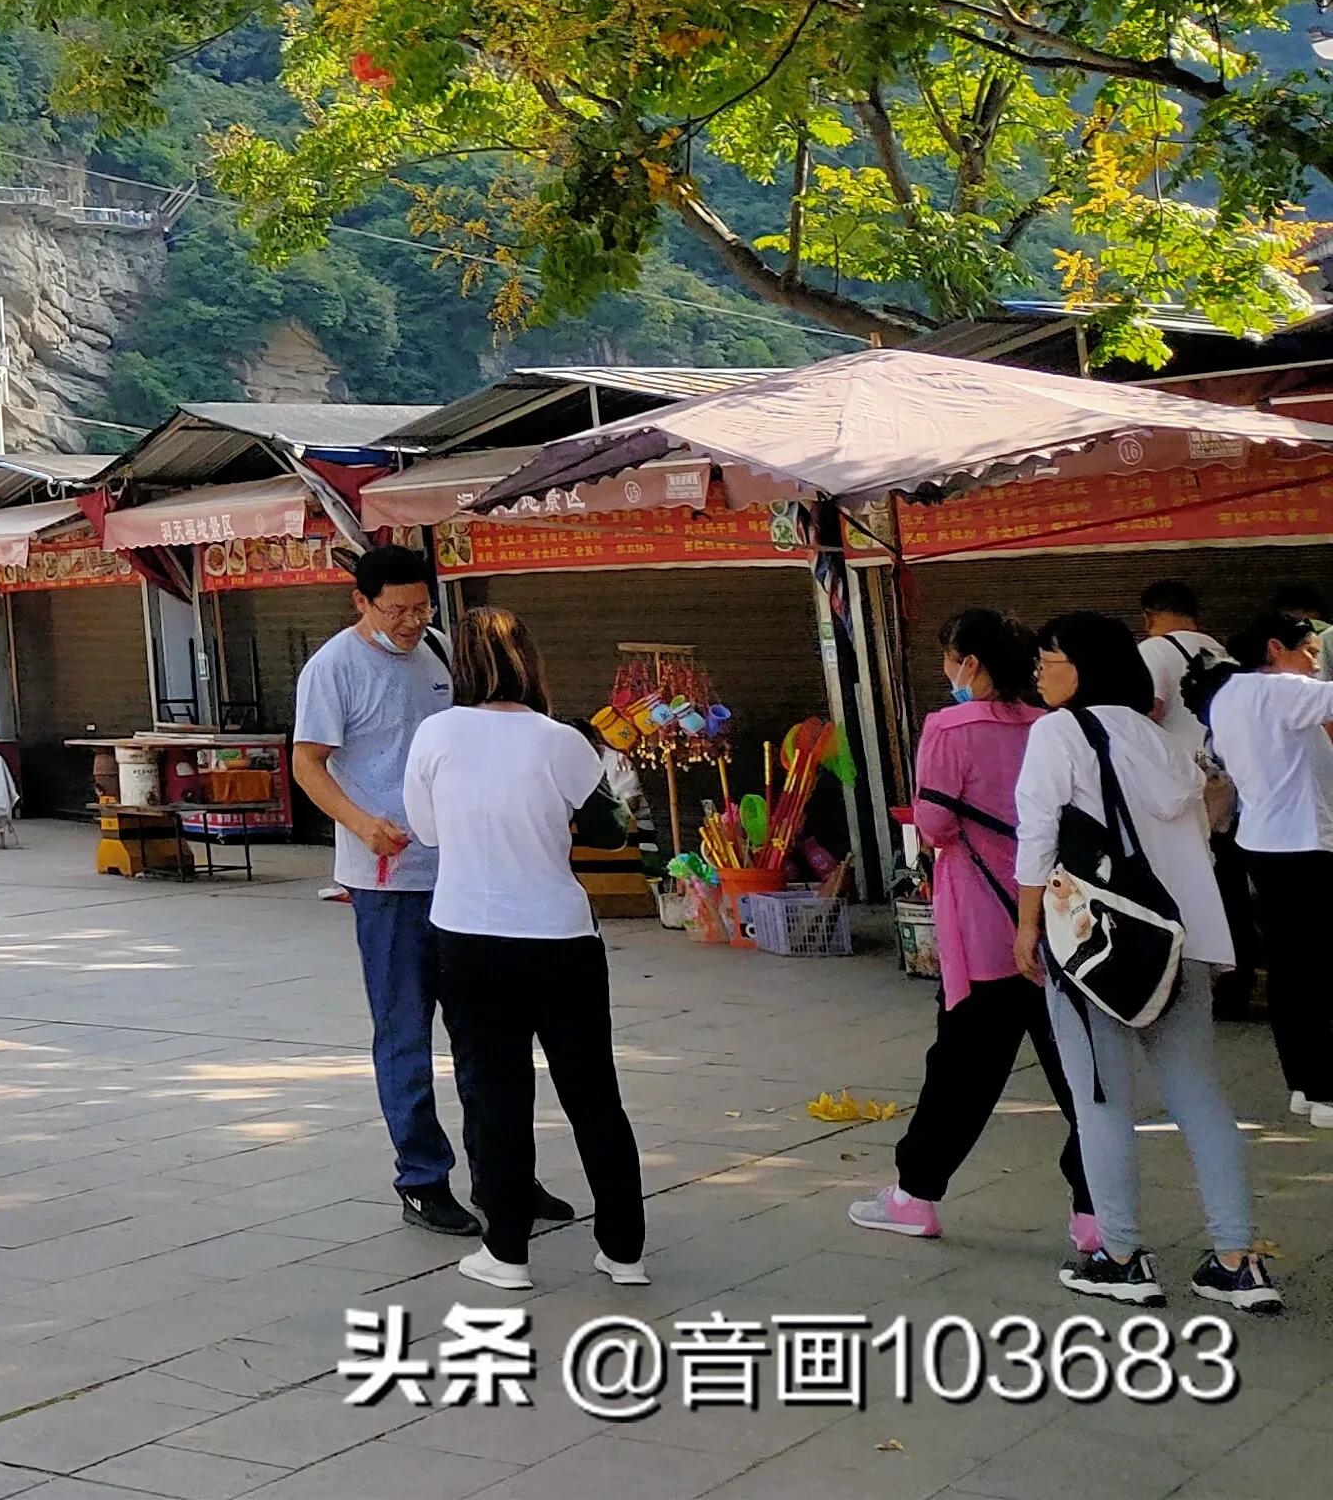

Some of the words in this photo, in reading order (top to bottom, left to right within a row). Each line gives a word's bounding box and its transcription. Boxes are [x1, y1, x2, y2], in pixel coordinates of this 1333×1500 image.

[1123, 444, 1139, 461] 16
[160, 514, 235, 541] 洞天福地景区
